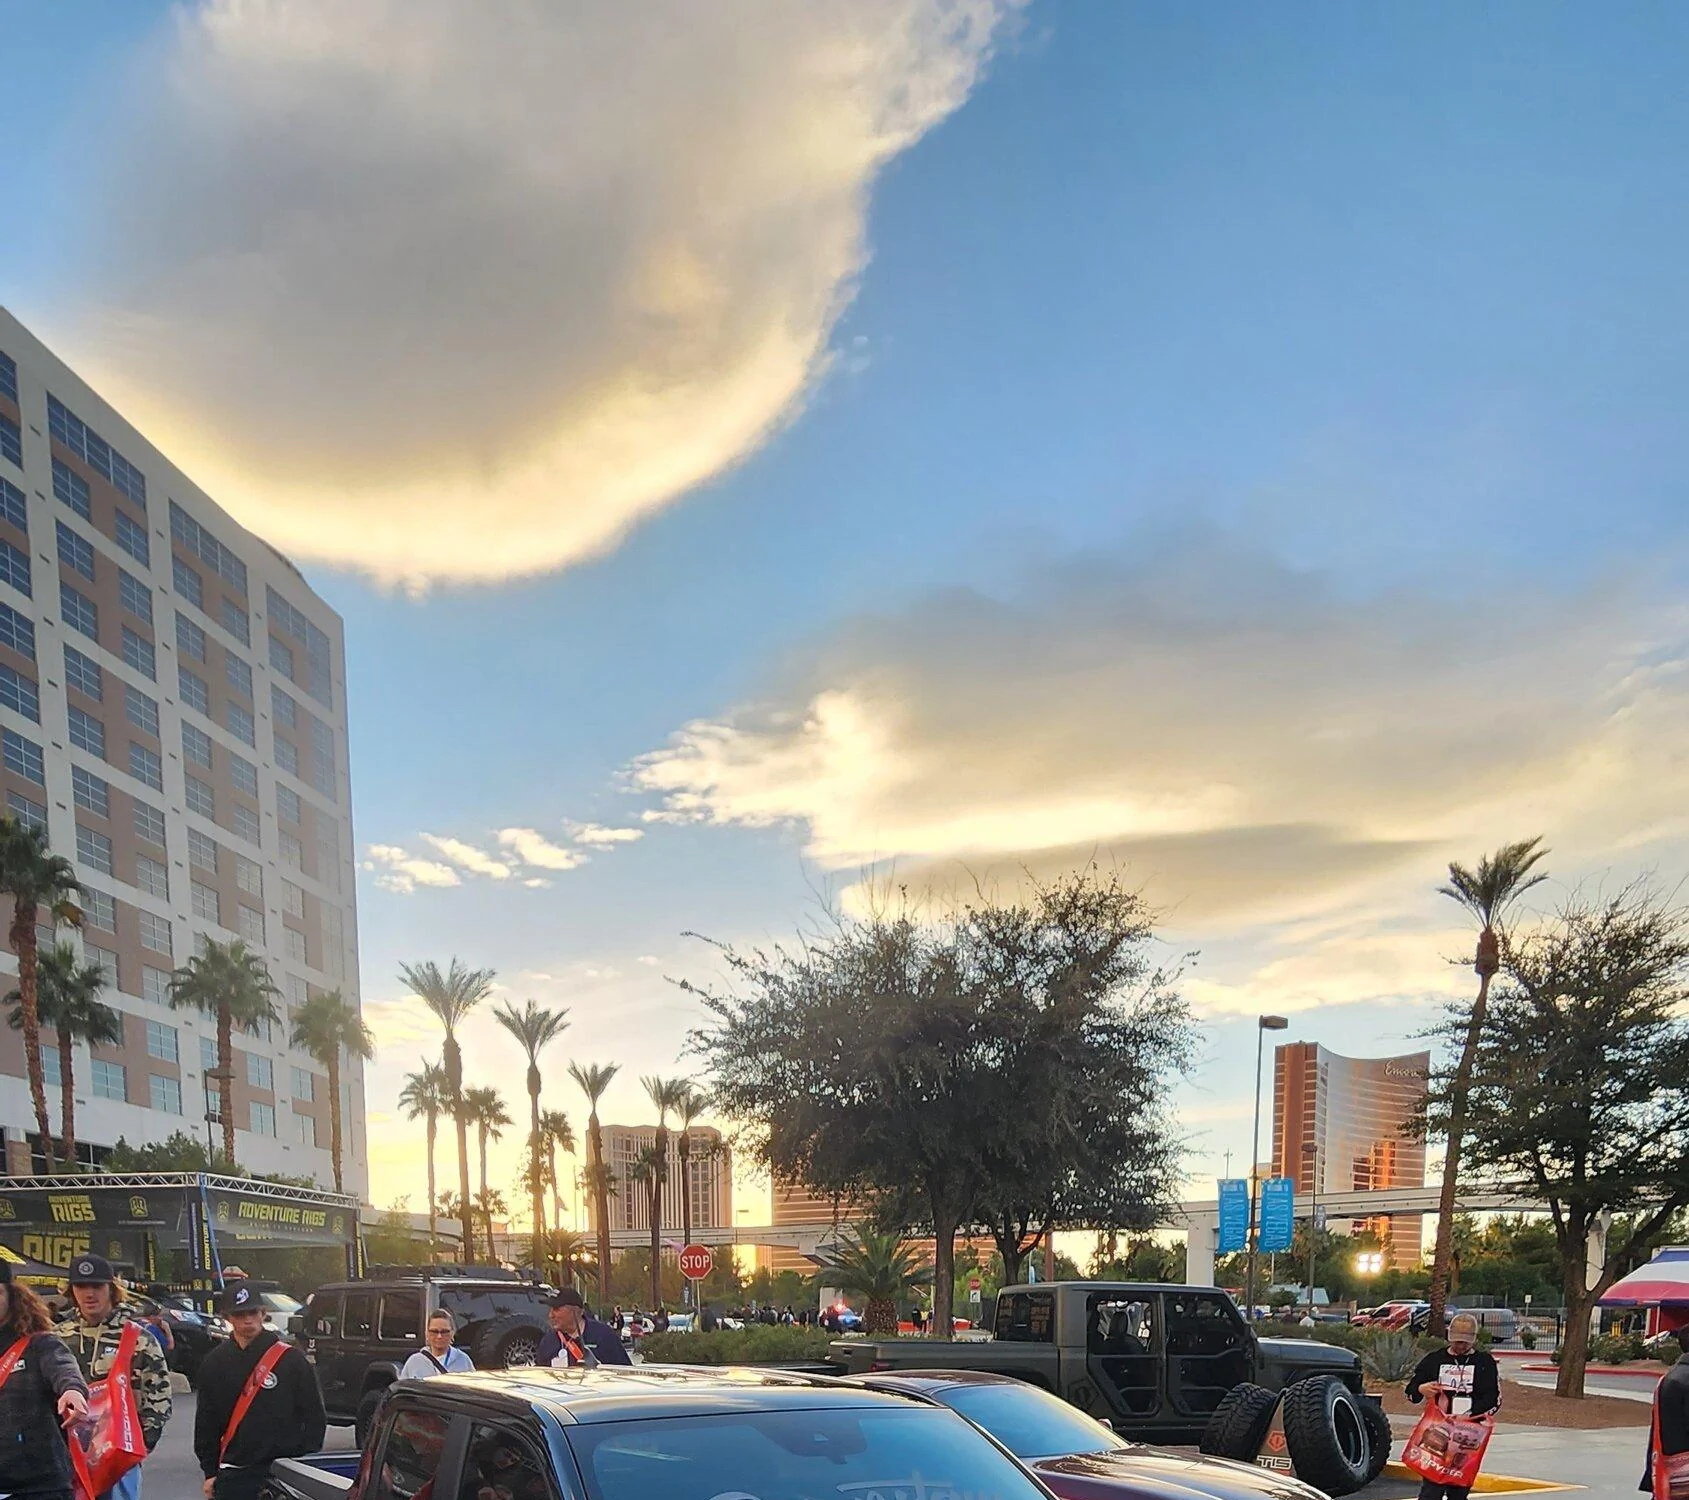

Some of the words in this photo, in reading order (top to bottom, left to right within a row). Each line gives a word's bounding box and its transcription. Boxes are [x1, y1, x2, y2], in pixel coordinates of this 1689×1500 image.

[1223, 1193, 1245, 1210] LAS
[1266, 1193, 1289, 1210] LAS
[51, 1203, 96, 1222] RIGS
[238, 1201, 300, 1224] ADVENTURE
[301, 1209, 327, 1227] RIGS
[1223, 1213, 1245, 1248] VEGAS
[1264, 1213, 1289, 1248] VEGAS
[681, 1255, 710, 1269] STOP
[1256, 1455, 1293, 1470] TIS
[1419, 1453, 1464, 1480] SPYDER
